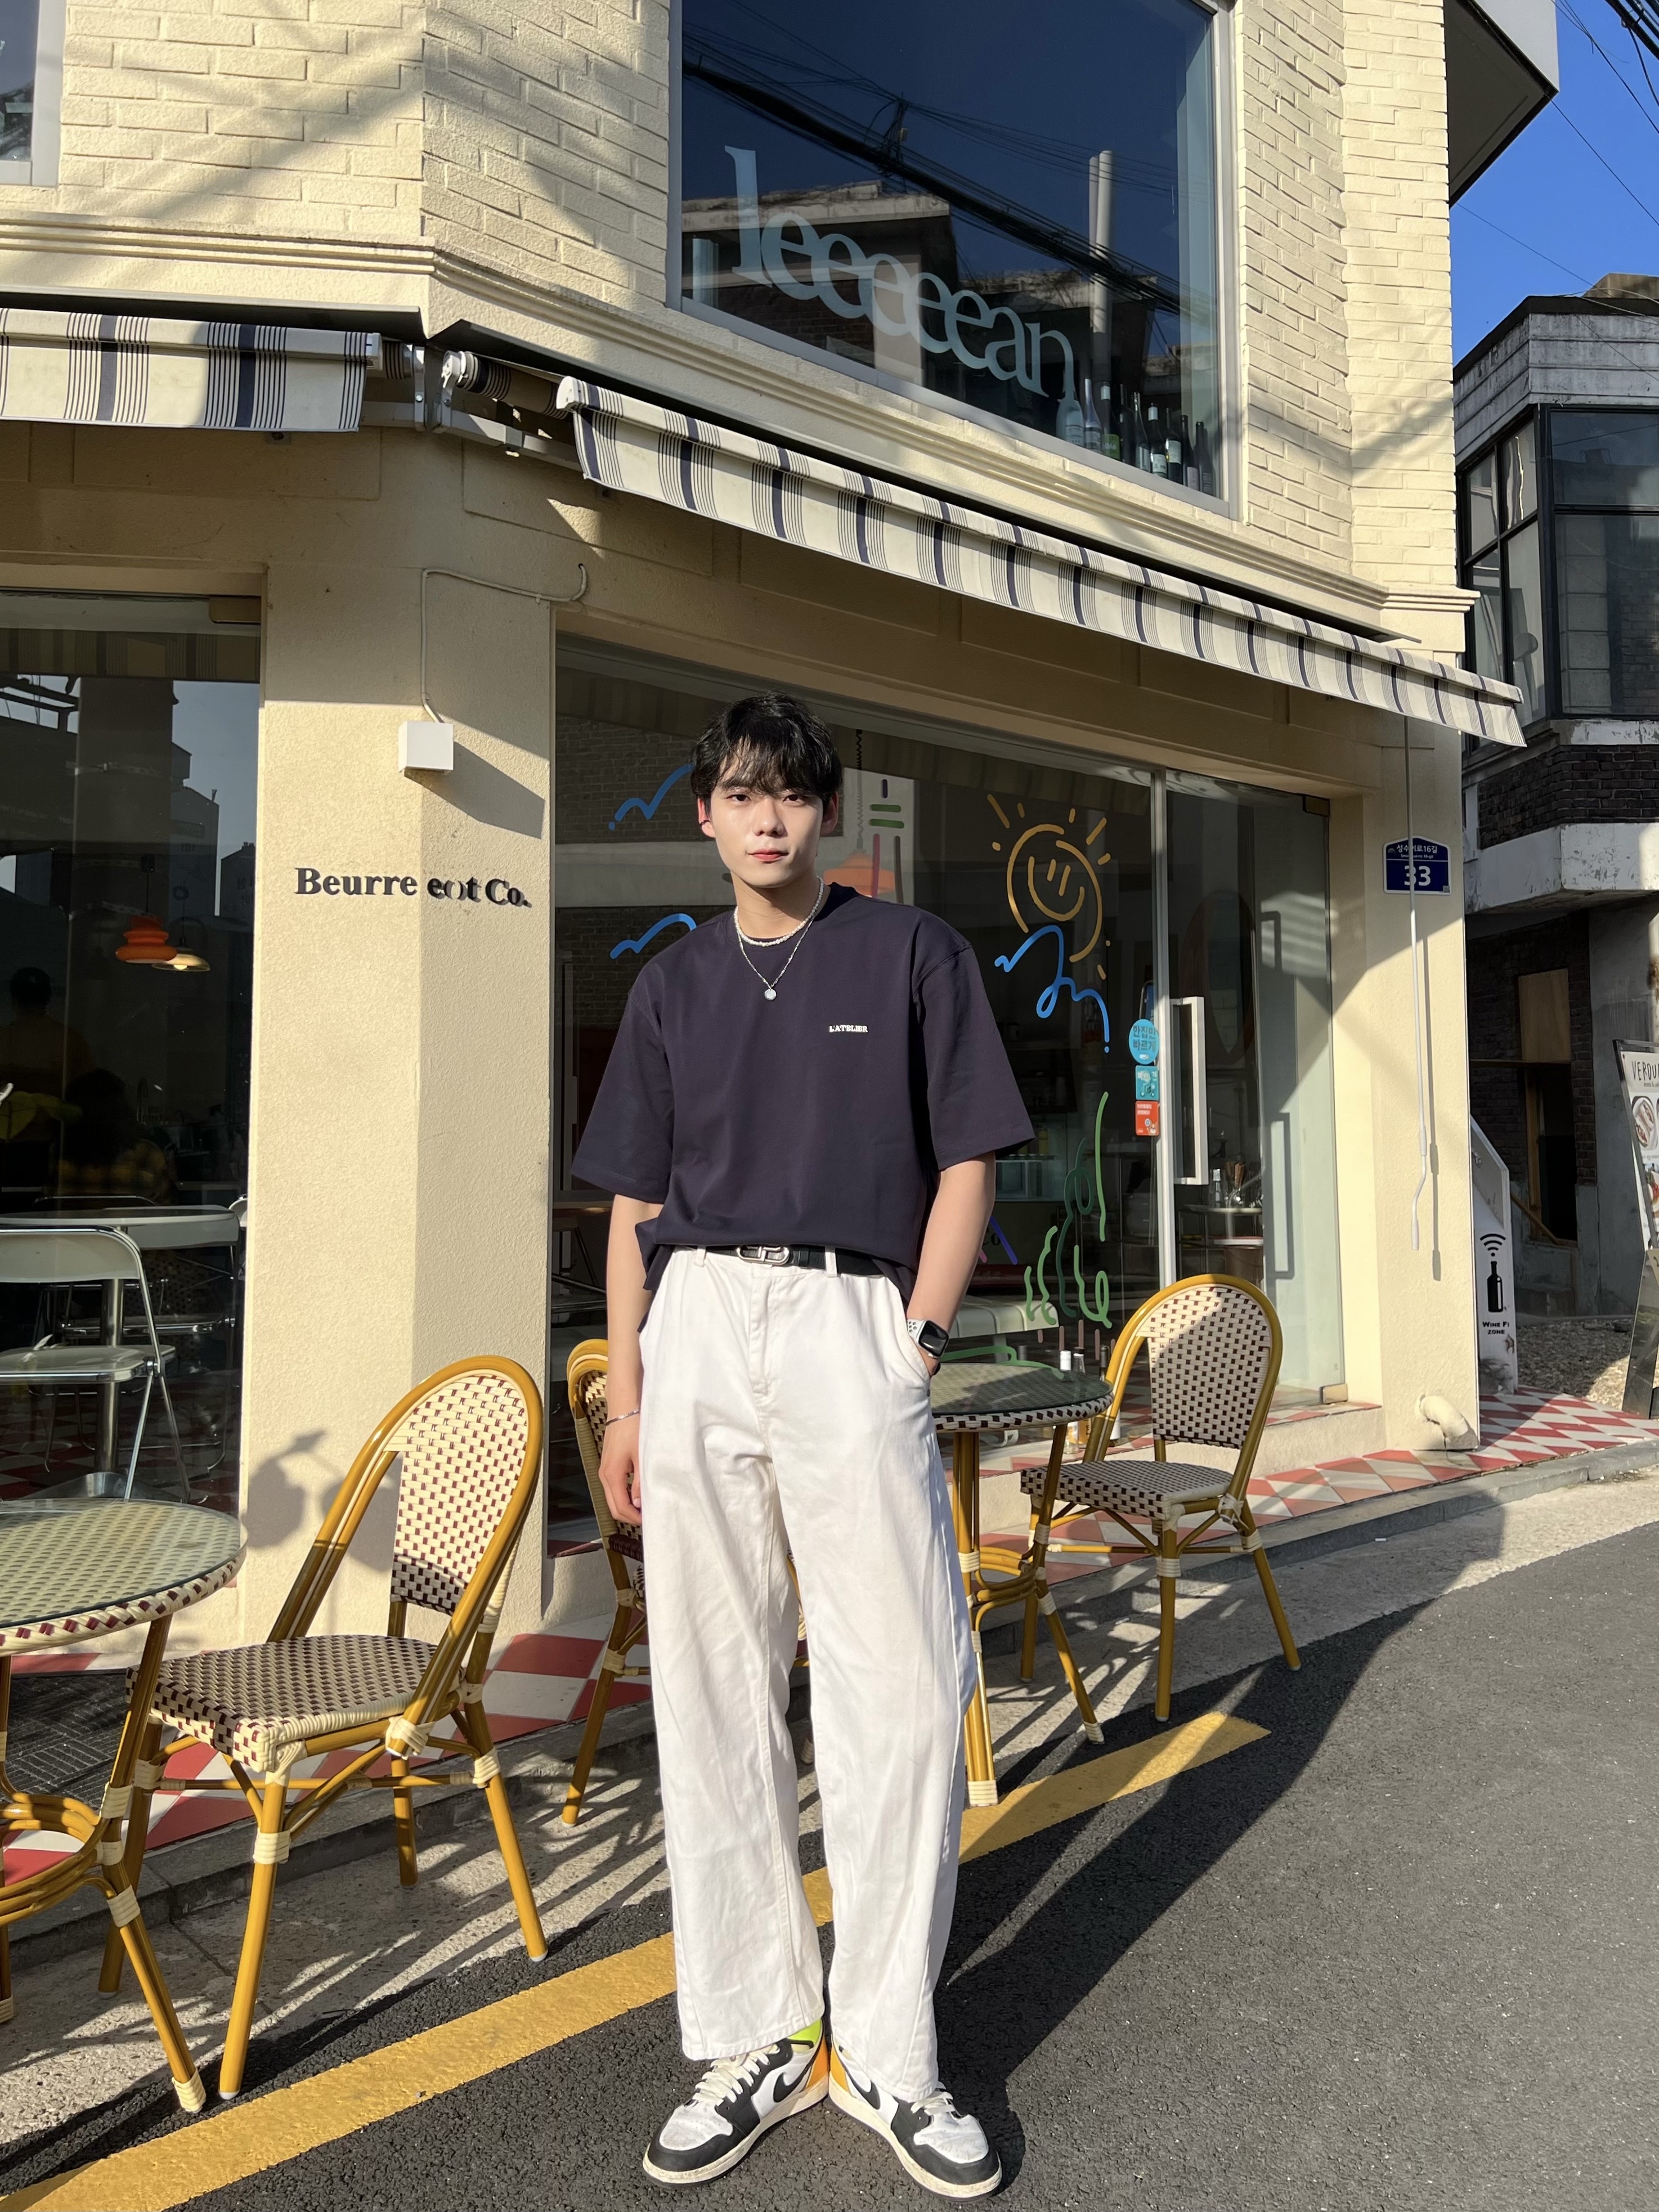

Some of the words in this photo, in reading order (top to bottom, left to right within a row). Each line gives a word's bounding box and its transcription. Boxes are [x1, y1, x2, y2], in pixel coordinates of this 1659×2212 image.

[1404, 865, 1431, 886] 33
[294, 867, 418, 896] Beurre
[485, 878, 532, 908] Co.
[1631, 1061, 1659, 1081] VEROU
